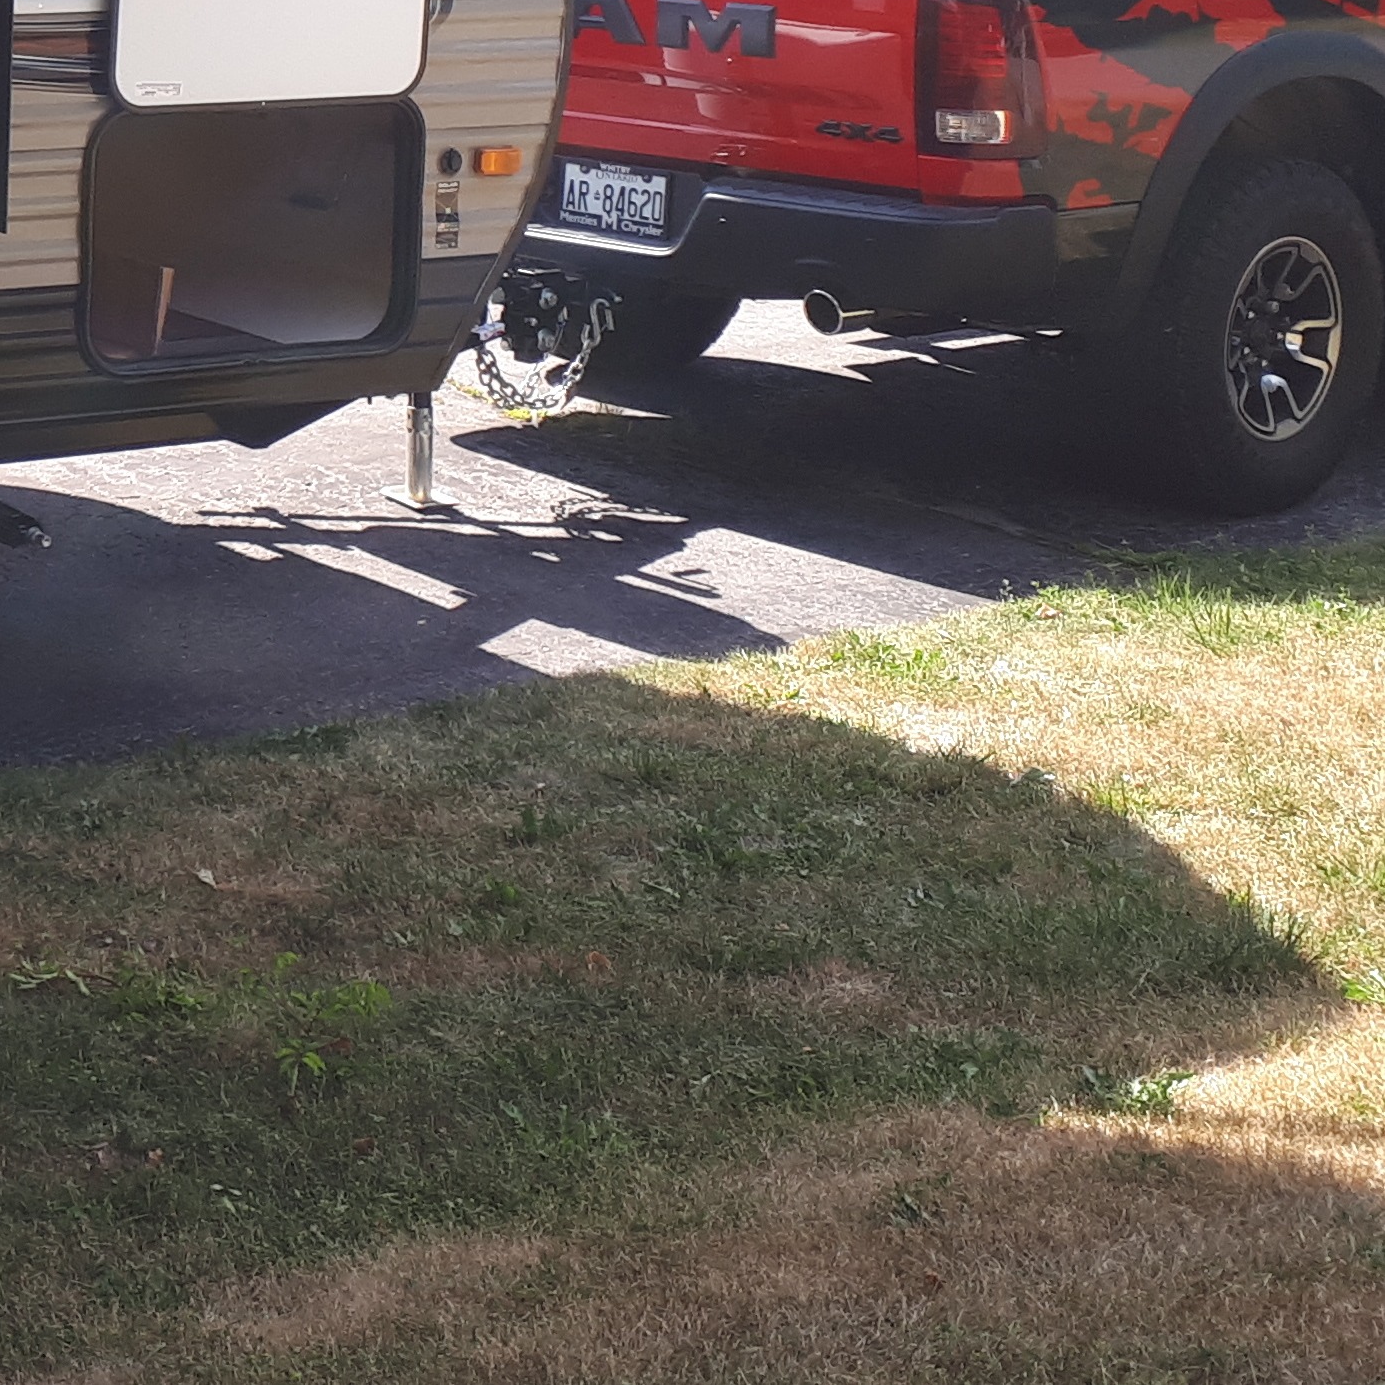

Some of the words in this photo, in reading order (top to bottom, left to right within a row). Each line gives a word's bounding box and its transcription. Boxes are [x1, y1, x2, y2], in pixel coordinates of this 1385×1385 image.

[566, 179, 590, 211] AR
[602, 184, 663, 221] 84620
[559, 209, 598, 226] Menzies
[620, 220, 664, 237] Chrysler
